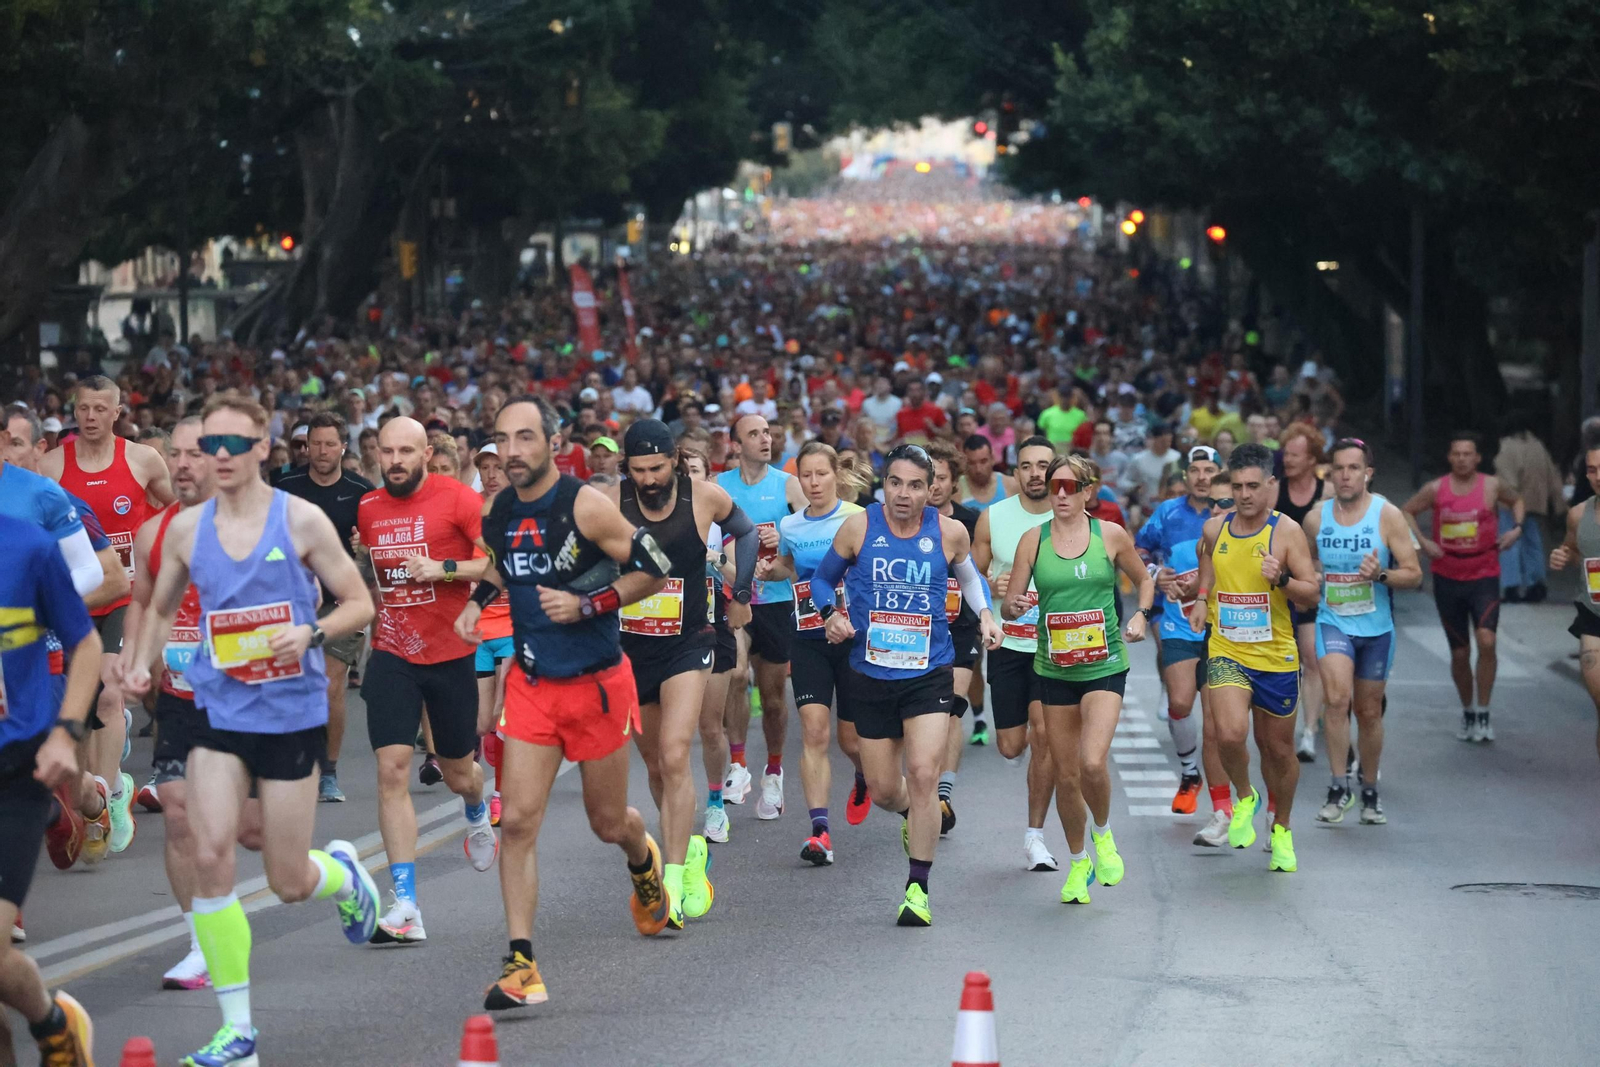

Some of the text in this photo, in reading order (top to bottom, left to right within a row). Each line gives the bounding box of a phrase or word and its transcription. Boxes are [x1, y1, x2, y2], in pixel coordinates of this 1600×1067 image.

[380, 517, 413, 527] GENERALI
[378, 531, 412, 546] MÁLAGA
[1321, 534, 1372, 552] nerja
[382, 548, 422, 559] GENERALI
[872, 557, 931, 584] RCM
[873, 590, 931, 611] 1873
[1228, 595, 1265, 604] GENERALI
[228, 607, 287, 625] GENERALI
[1060, 613, 1100, 624] GENERALI
[1227, 610, 1258, 621] 17699
[880, 631, 917, 645] 12502
[1065, 631, 1088, 642] 827
